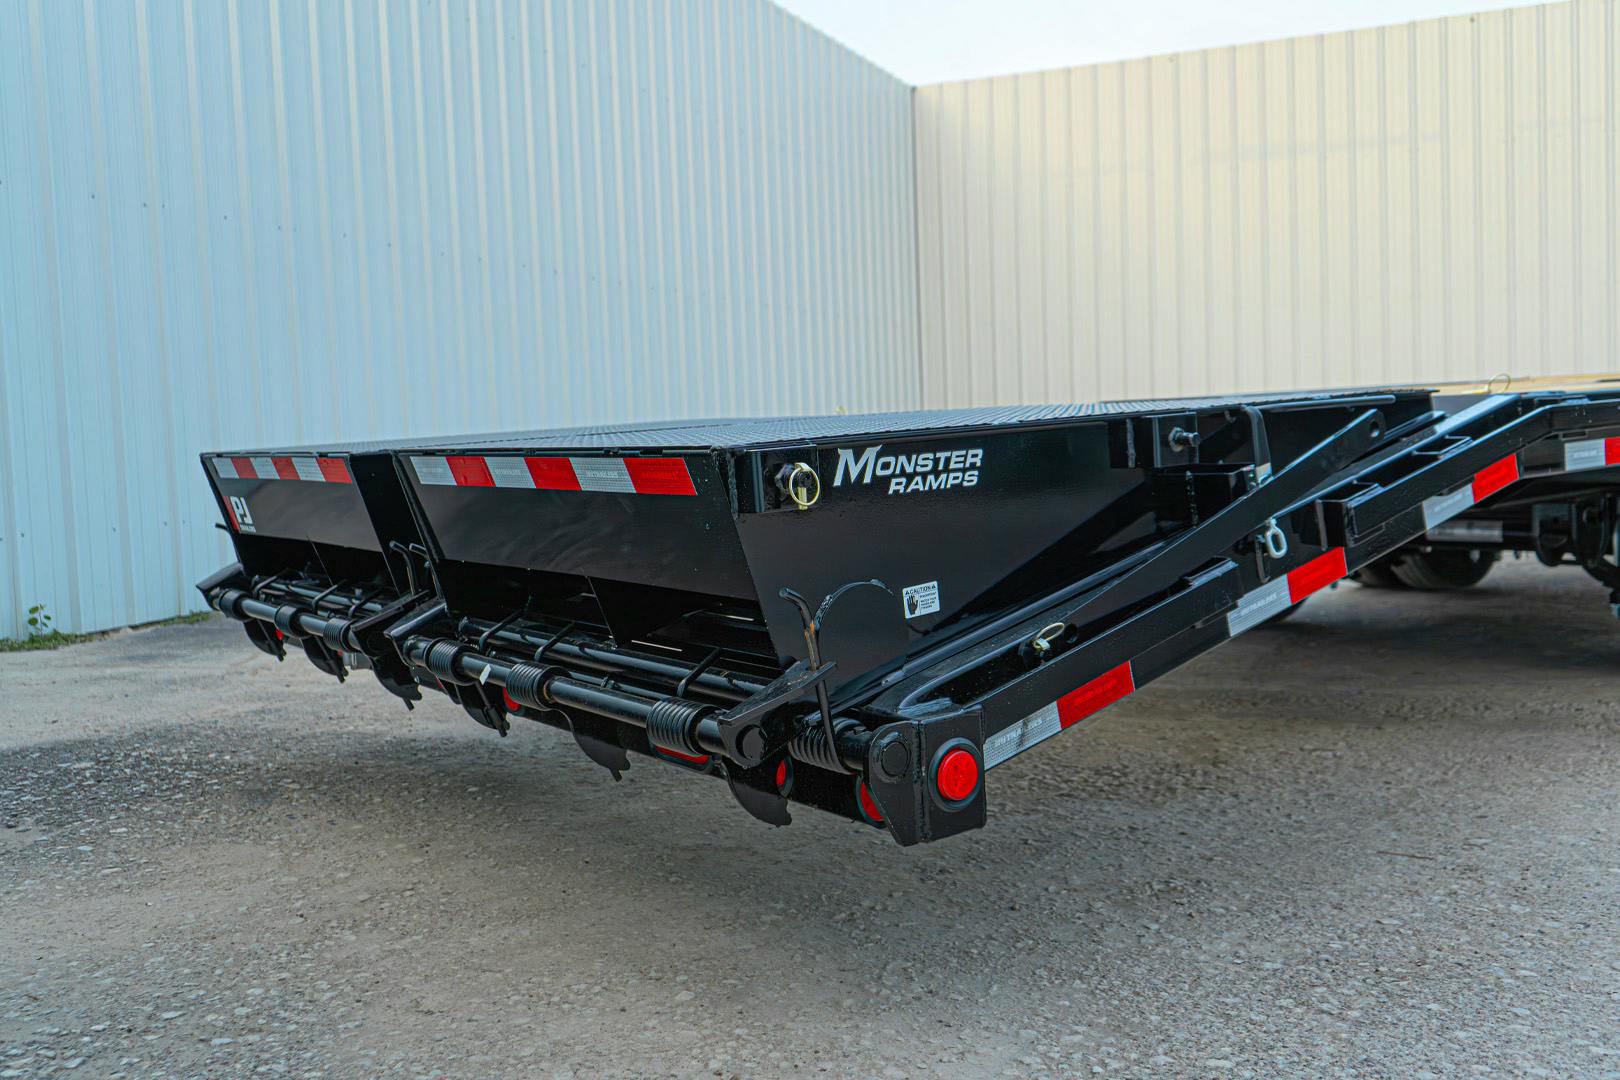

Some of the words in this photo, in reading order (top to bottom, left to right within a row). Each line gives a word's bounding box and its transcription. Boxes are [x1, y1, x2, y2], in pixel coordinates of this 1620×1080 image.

[832, 443, 983, 487] MONSTER
[888, 470, 979, 495] RAMPS
[229, 496, 253, 524] PJ
[910, 585, 931, 595] CAUTION
